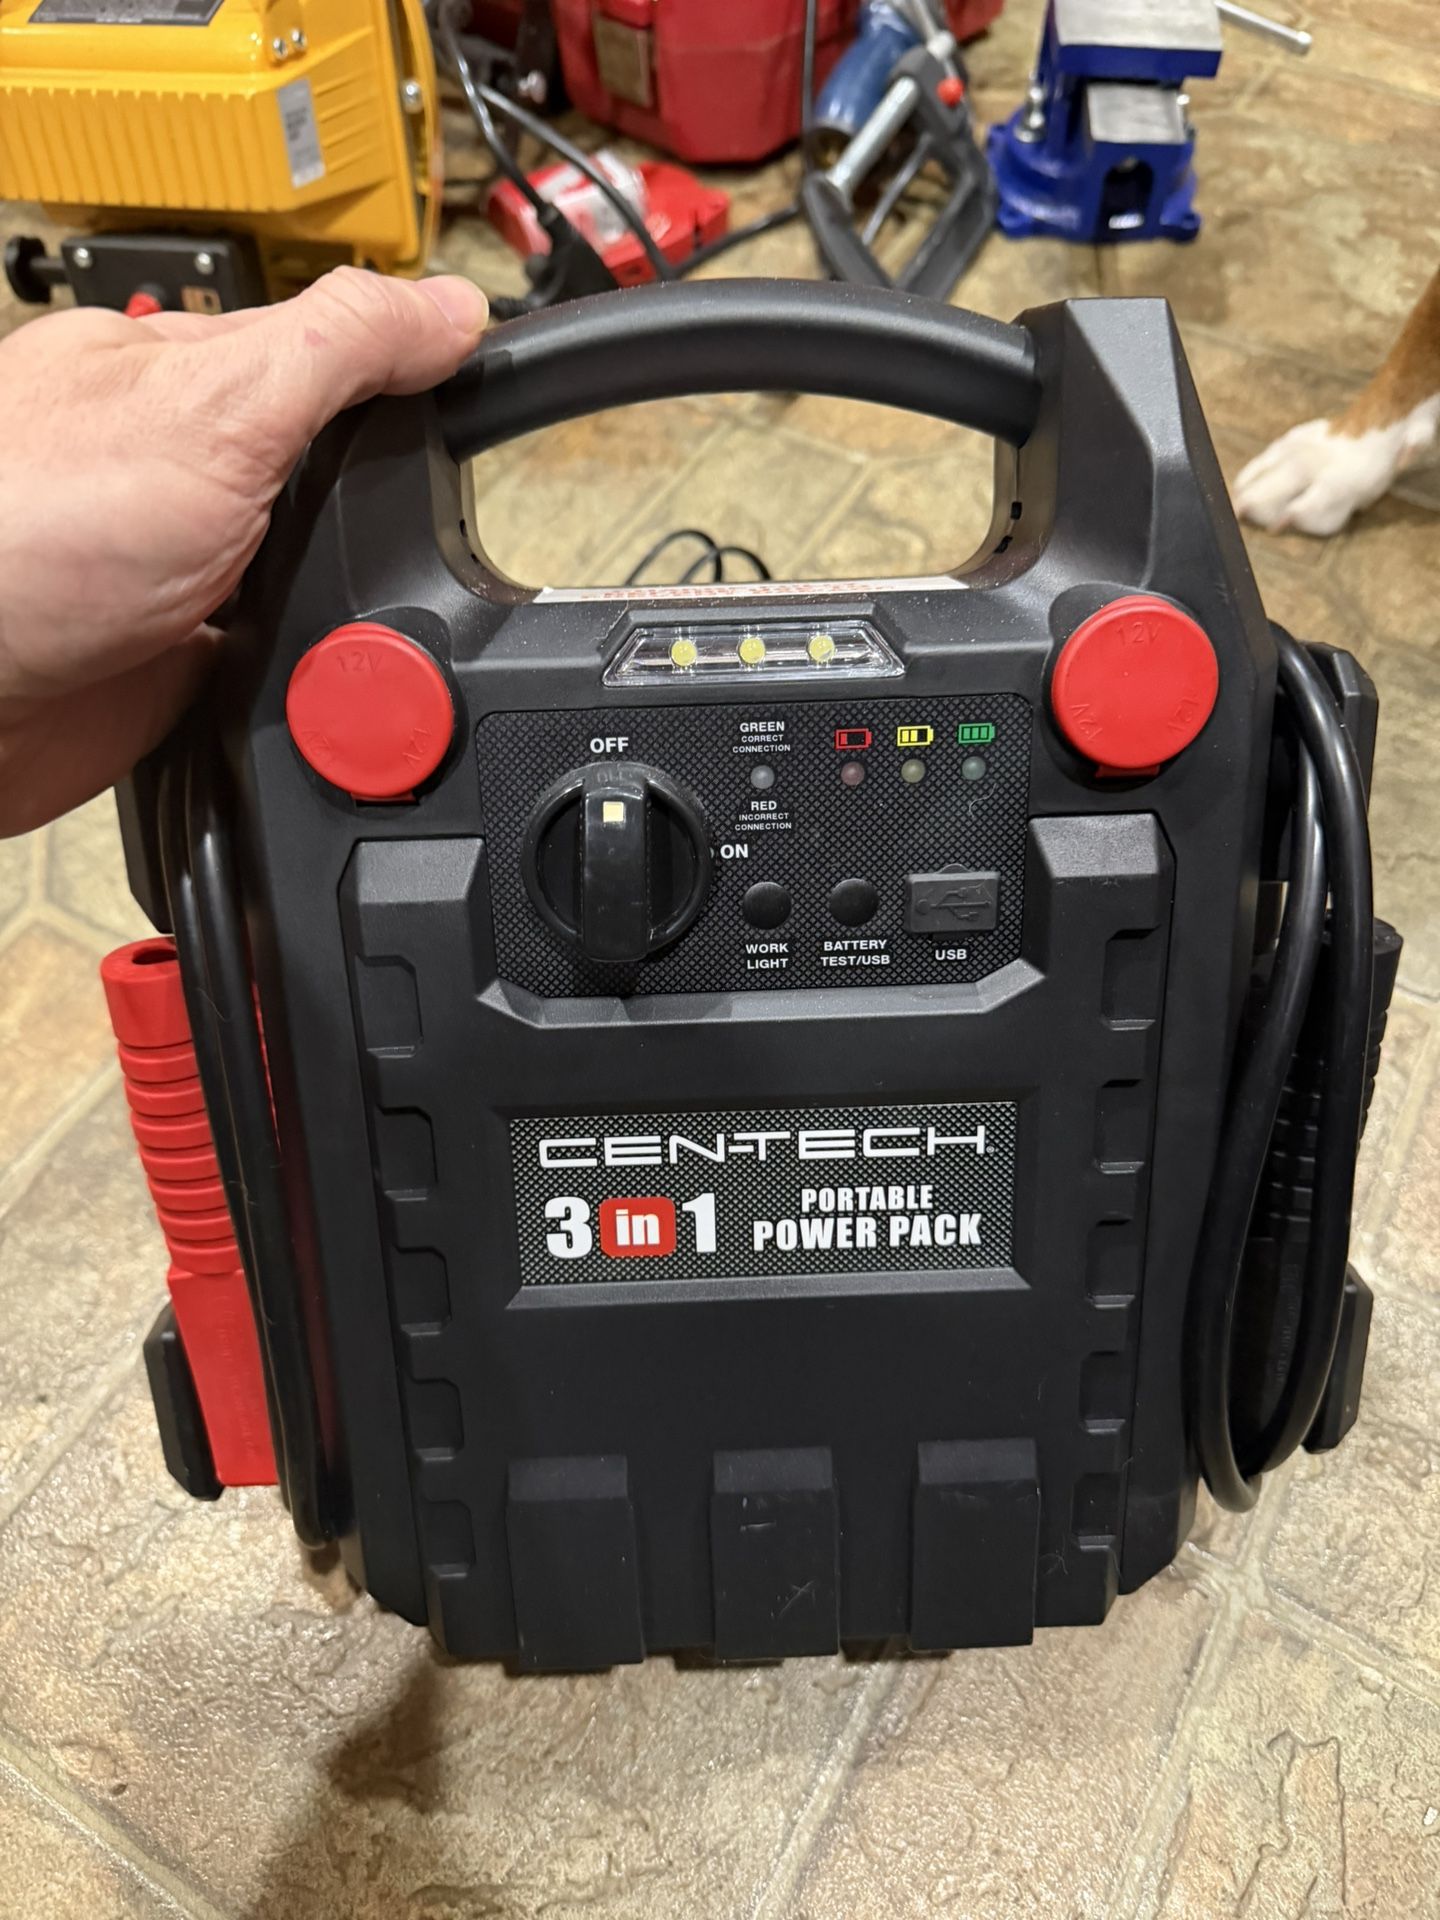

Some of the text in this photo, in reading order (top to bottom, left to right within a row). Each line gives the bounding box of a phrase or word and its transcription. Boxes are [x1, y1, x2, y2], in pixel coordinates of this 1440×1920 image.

[1114, 620, 1163, 647] 12V
[335, 650, 384, 673] 12V
[739, 720, 786, 733] GREEN
[589, 736, 630, 754] OFF
[740, 734, 785, 743] CORRECT
[732, 744, 792, 754] CONNECTION
[750, 800, 778, 811] RED
[738, 812, 790, 822] INCORRECT
[734, 822, 793, 831] CONNECTION
[719, 843, 749, 859] ON
[745, 942, 789, 955] WORK
[823, 939, 888, 952] BATTERY
[820, 954, 891, 967] TEST/USB
[934, 948, 968, 961] USB
[746, 957, 789, 970] LIGHT
[538, 1125, 986, 1169] CEN-TECH
[801, 1184, 934, 1213] PORTABLE
[543, 1192, 718, 1260] 3 in 1
[752, 1212, 983, 1253] POWER PACK
